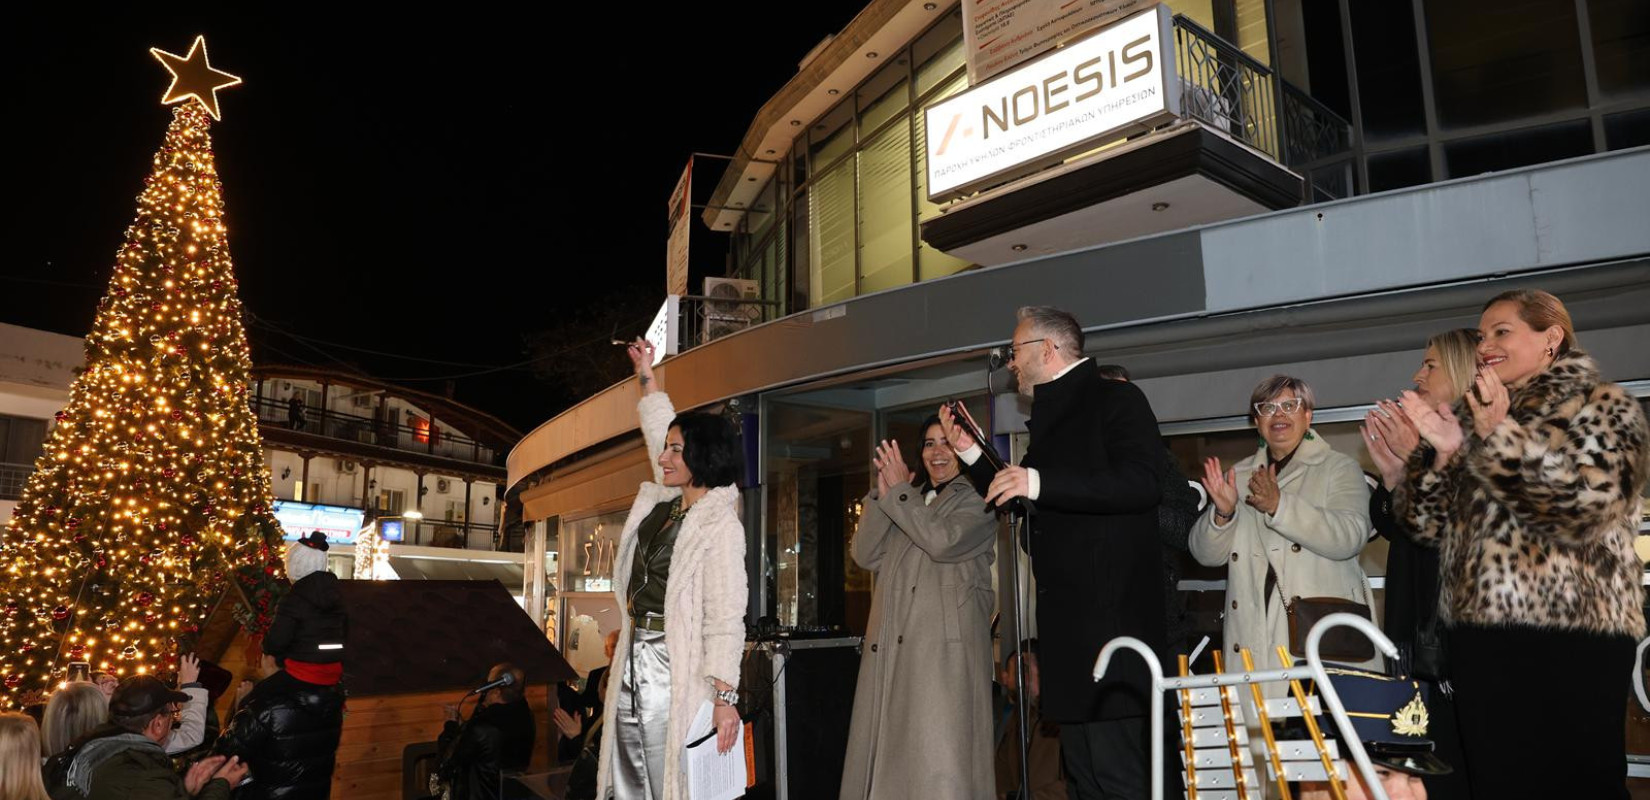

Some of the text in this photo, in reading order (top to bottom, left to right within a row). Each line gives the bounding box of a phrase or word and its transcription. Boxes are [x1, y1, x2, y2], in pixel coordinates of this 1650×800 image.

[934, 161, 968, 179] ΠΑΡΟΧΗ
[1008, 110, 1095, 150] ΦΡΟΝΤΙΣΤΗΡΙΑΚΩΝ
[1097, 86, 1156, 116] ΥΠΗΡΕΣΙΩΝ
[982, 34, 1153, 140] NOESIS
